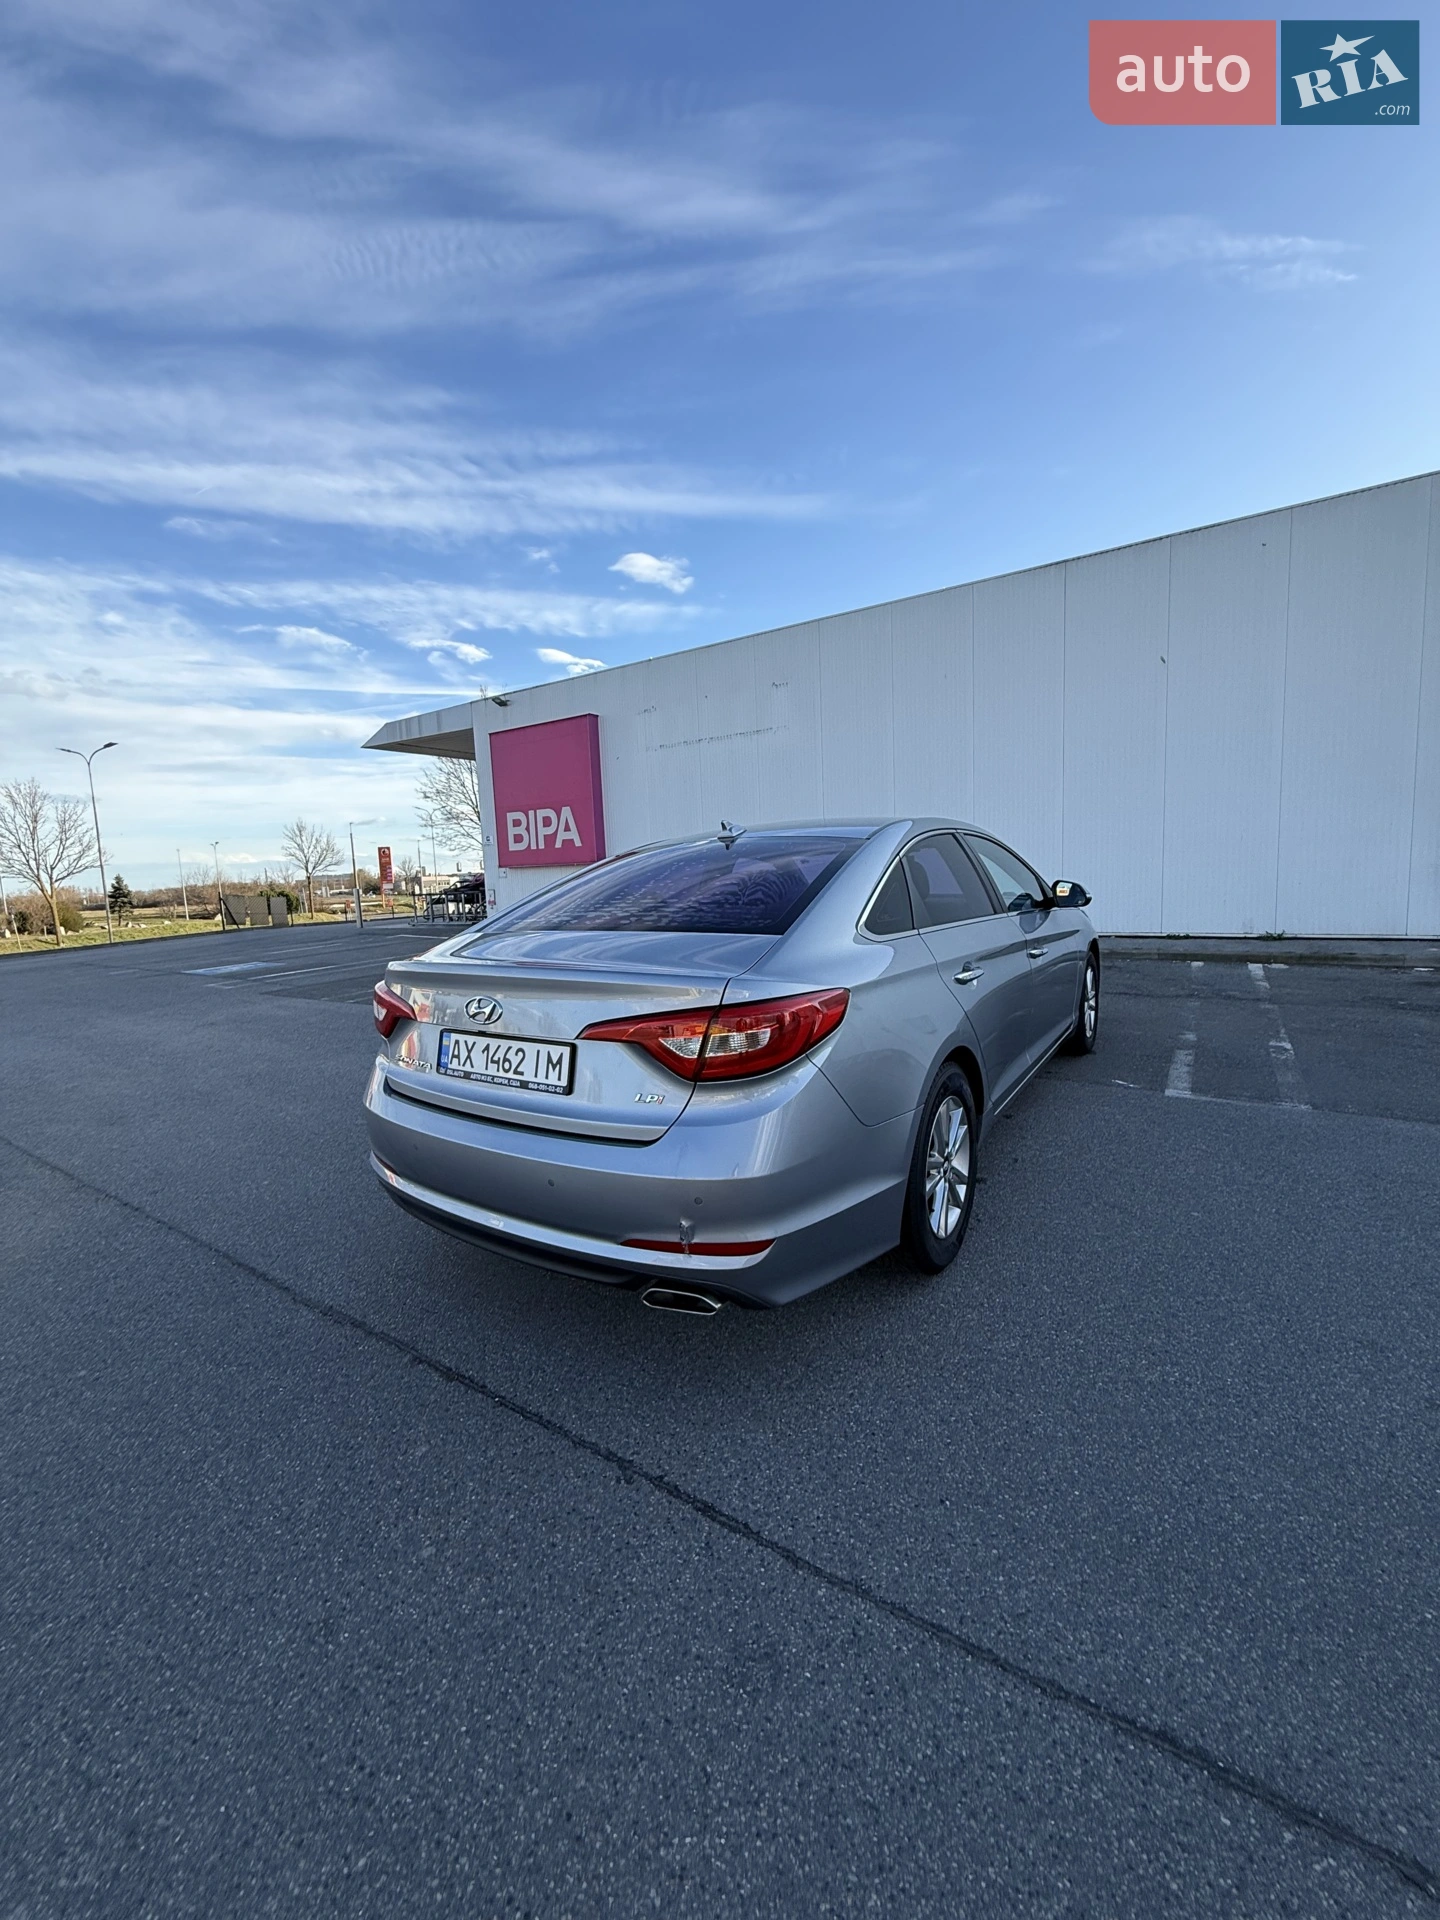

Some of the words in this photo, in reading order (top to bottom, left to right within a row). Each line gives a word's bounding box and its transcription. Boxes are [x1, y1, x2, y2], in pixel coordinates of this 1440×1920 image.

[506, 806, 583, 851] BIPA
[395, 1053, 433, 1070] SONATA
[441, 1054, 448, 1063] UA
[450, 1039, 477, 1068] AX
[481, 1043, 526, 1076] 1462
[534, 1049, 564, 1082] IM
